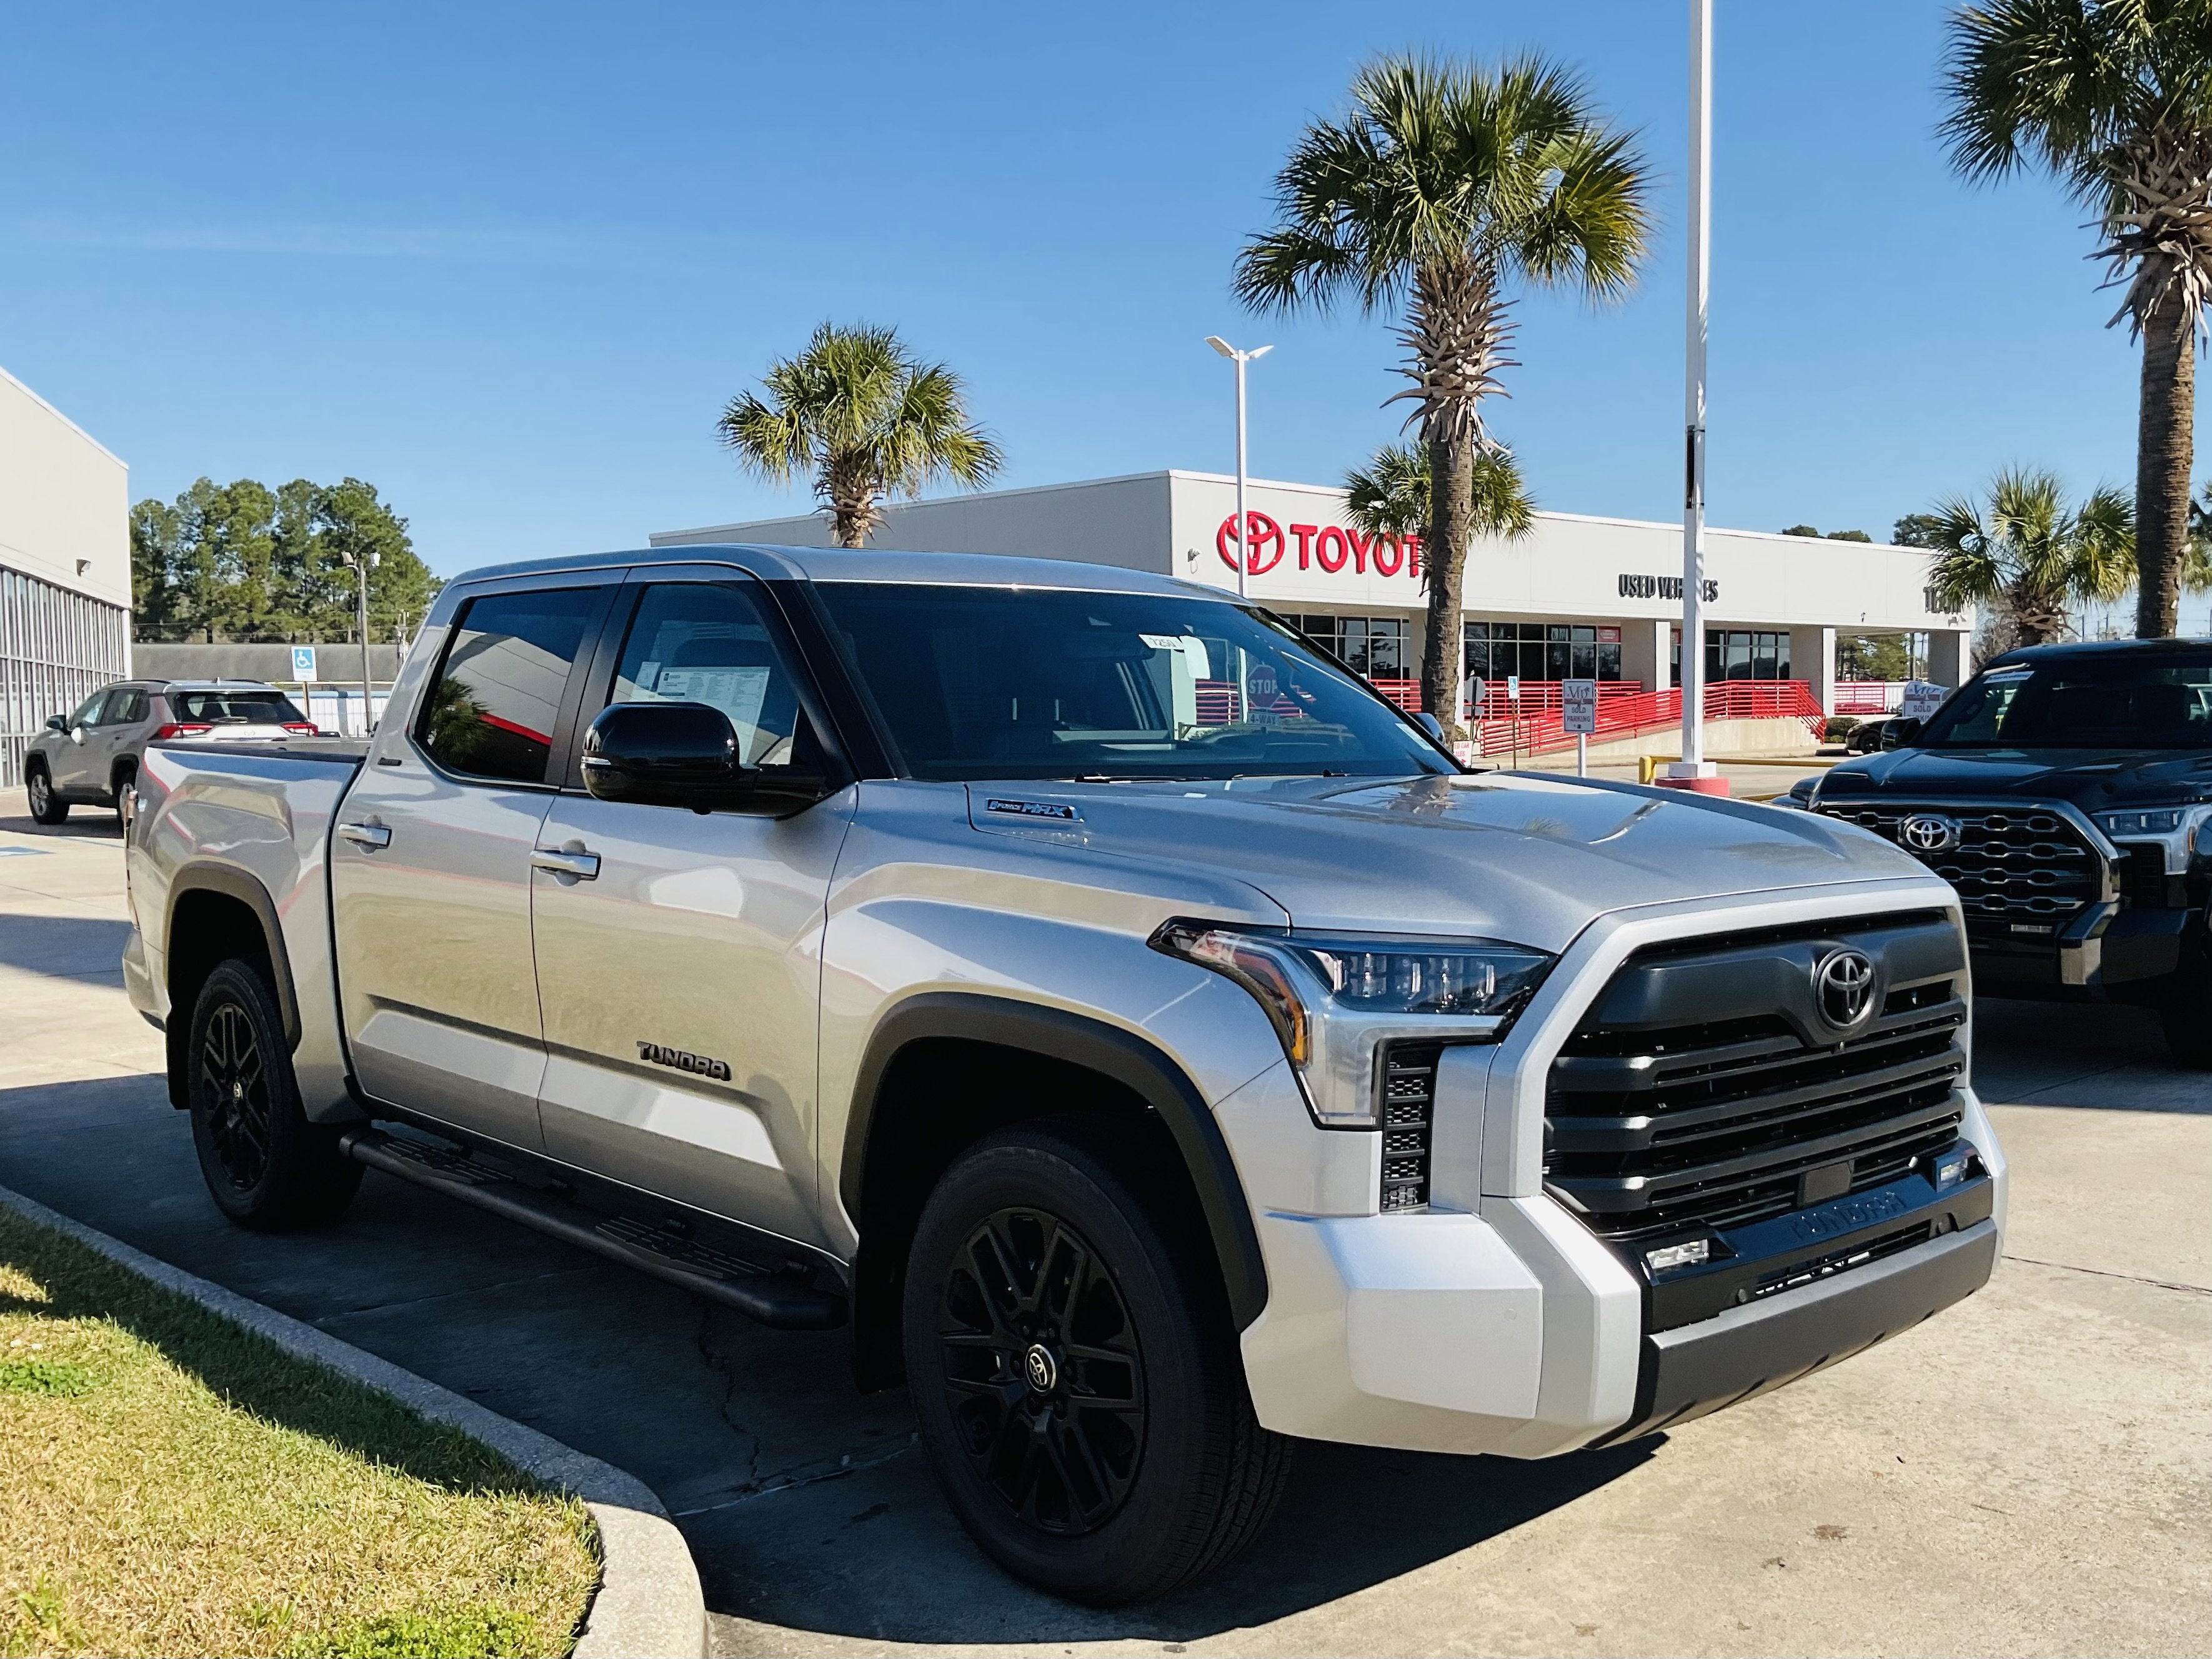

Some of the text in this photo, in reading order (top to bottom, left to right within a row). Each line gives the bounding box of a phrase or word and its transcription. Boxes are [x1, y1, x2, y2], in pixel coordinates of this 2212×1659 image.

[1290, 524, 1425, 578] TOYOT
[1619, 574, 1718, 602] USED VEHES
[1249, 679, 1278, 694] STOP
[1250, 714, 1277, 724] 4-WAY
[1022, 802, 1068, 817] MAX
[636, 1040, 732, 1082] TUNDRA
[1788, 1192, 1907, 1240] TUNDRA
